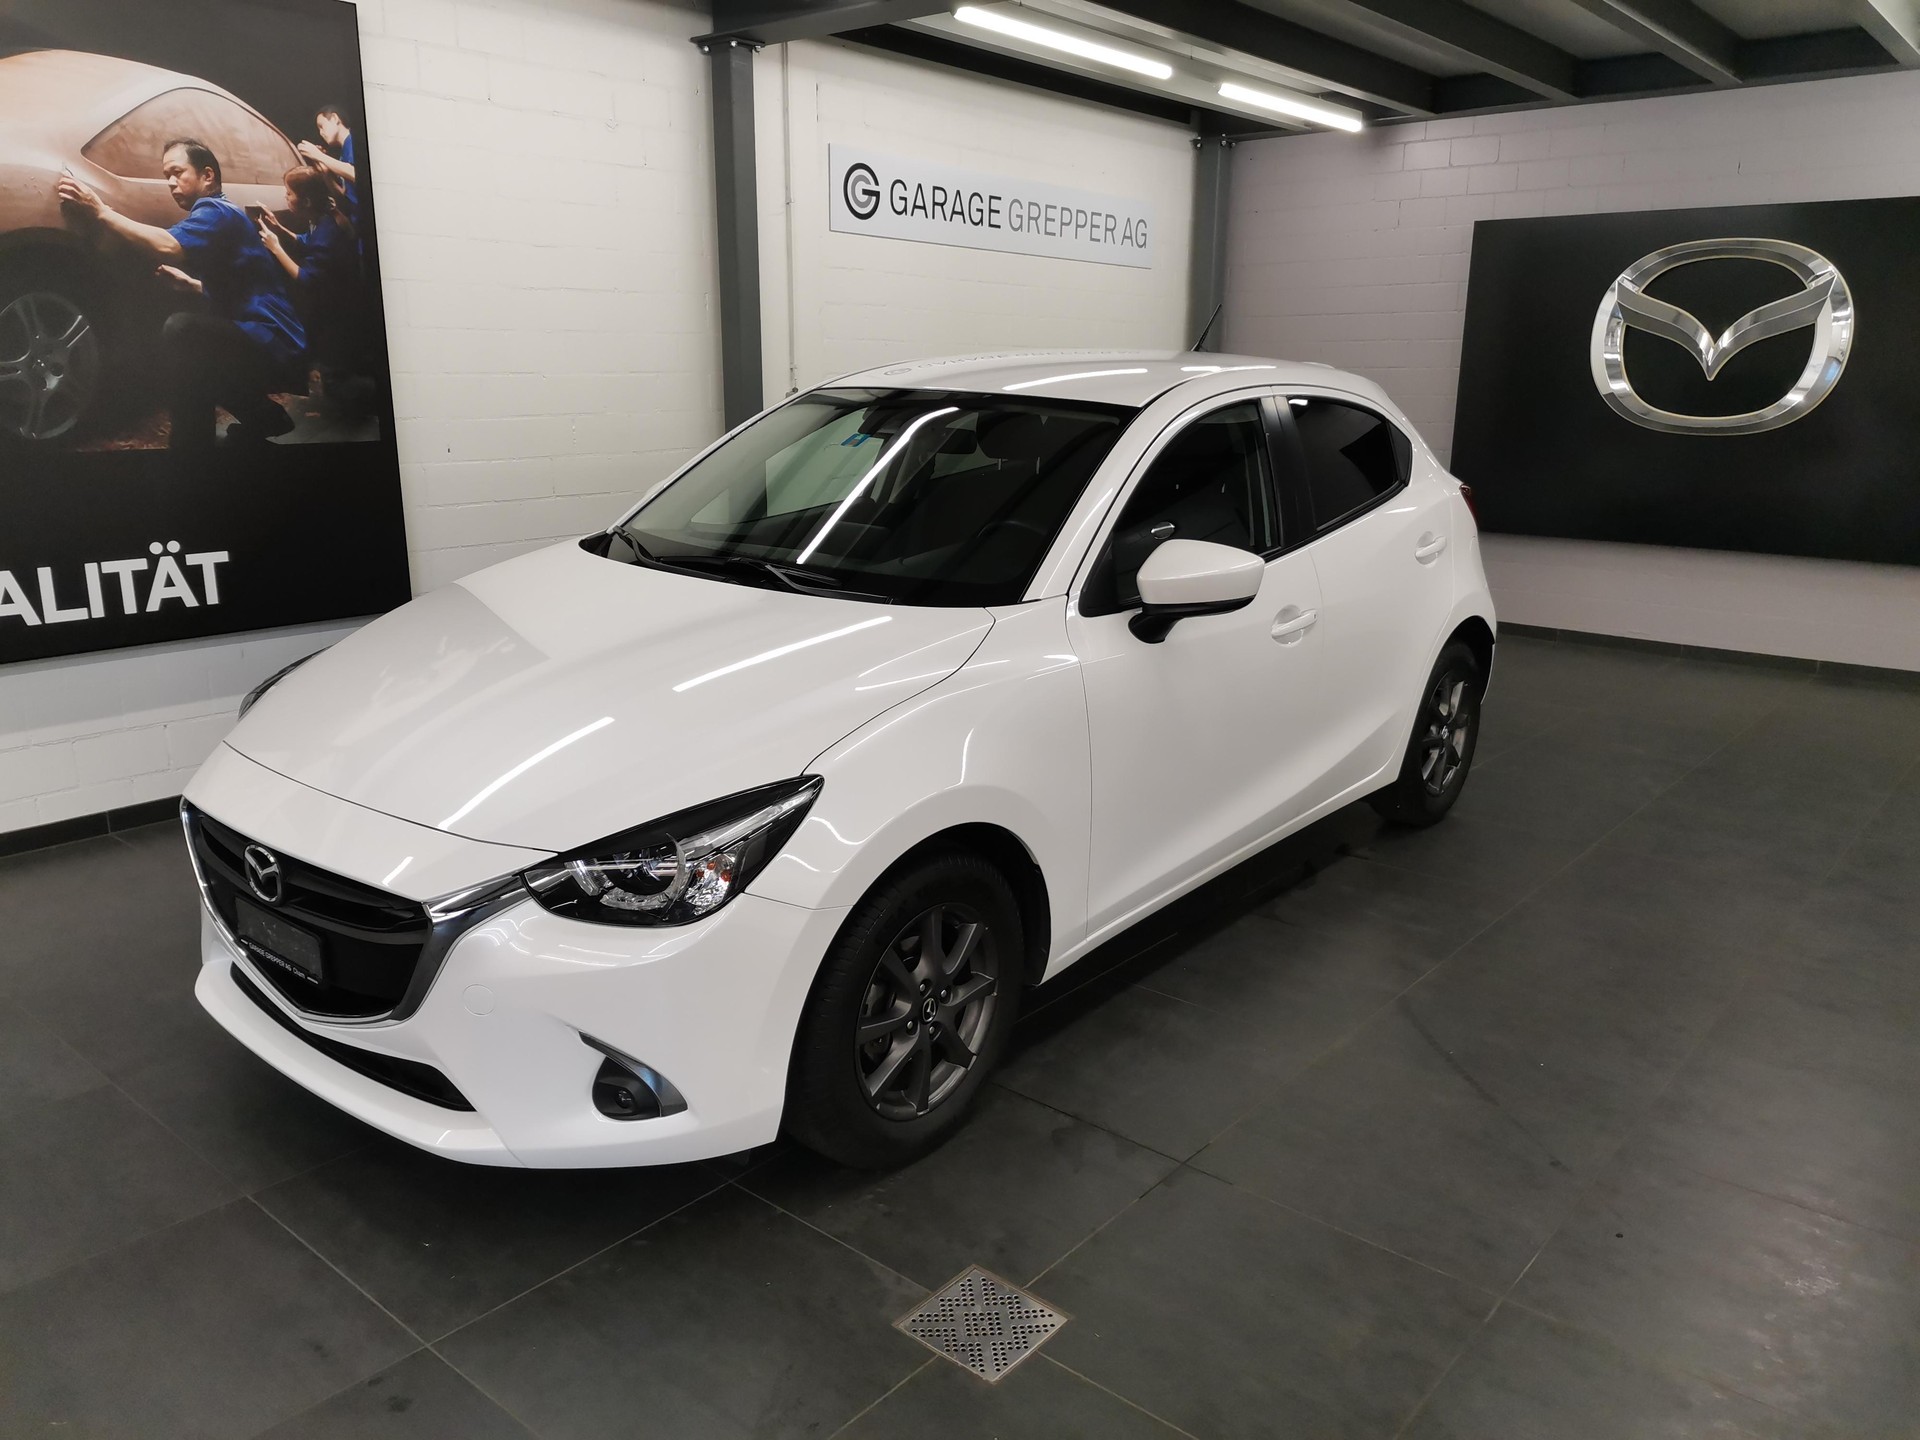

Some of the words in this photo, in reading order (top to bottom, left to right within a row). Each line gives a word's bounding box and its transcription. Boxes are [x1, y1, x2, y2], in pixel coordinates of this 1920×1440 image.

[889, 178, 1002, 230] GARAGE
[1008, 198, 1117, 245] GREPPER
[1120, 216, 1148, 249] AG
[0, 540, 229, 626] ALITÄT
